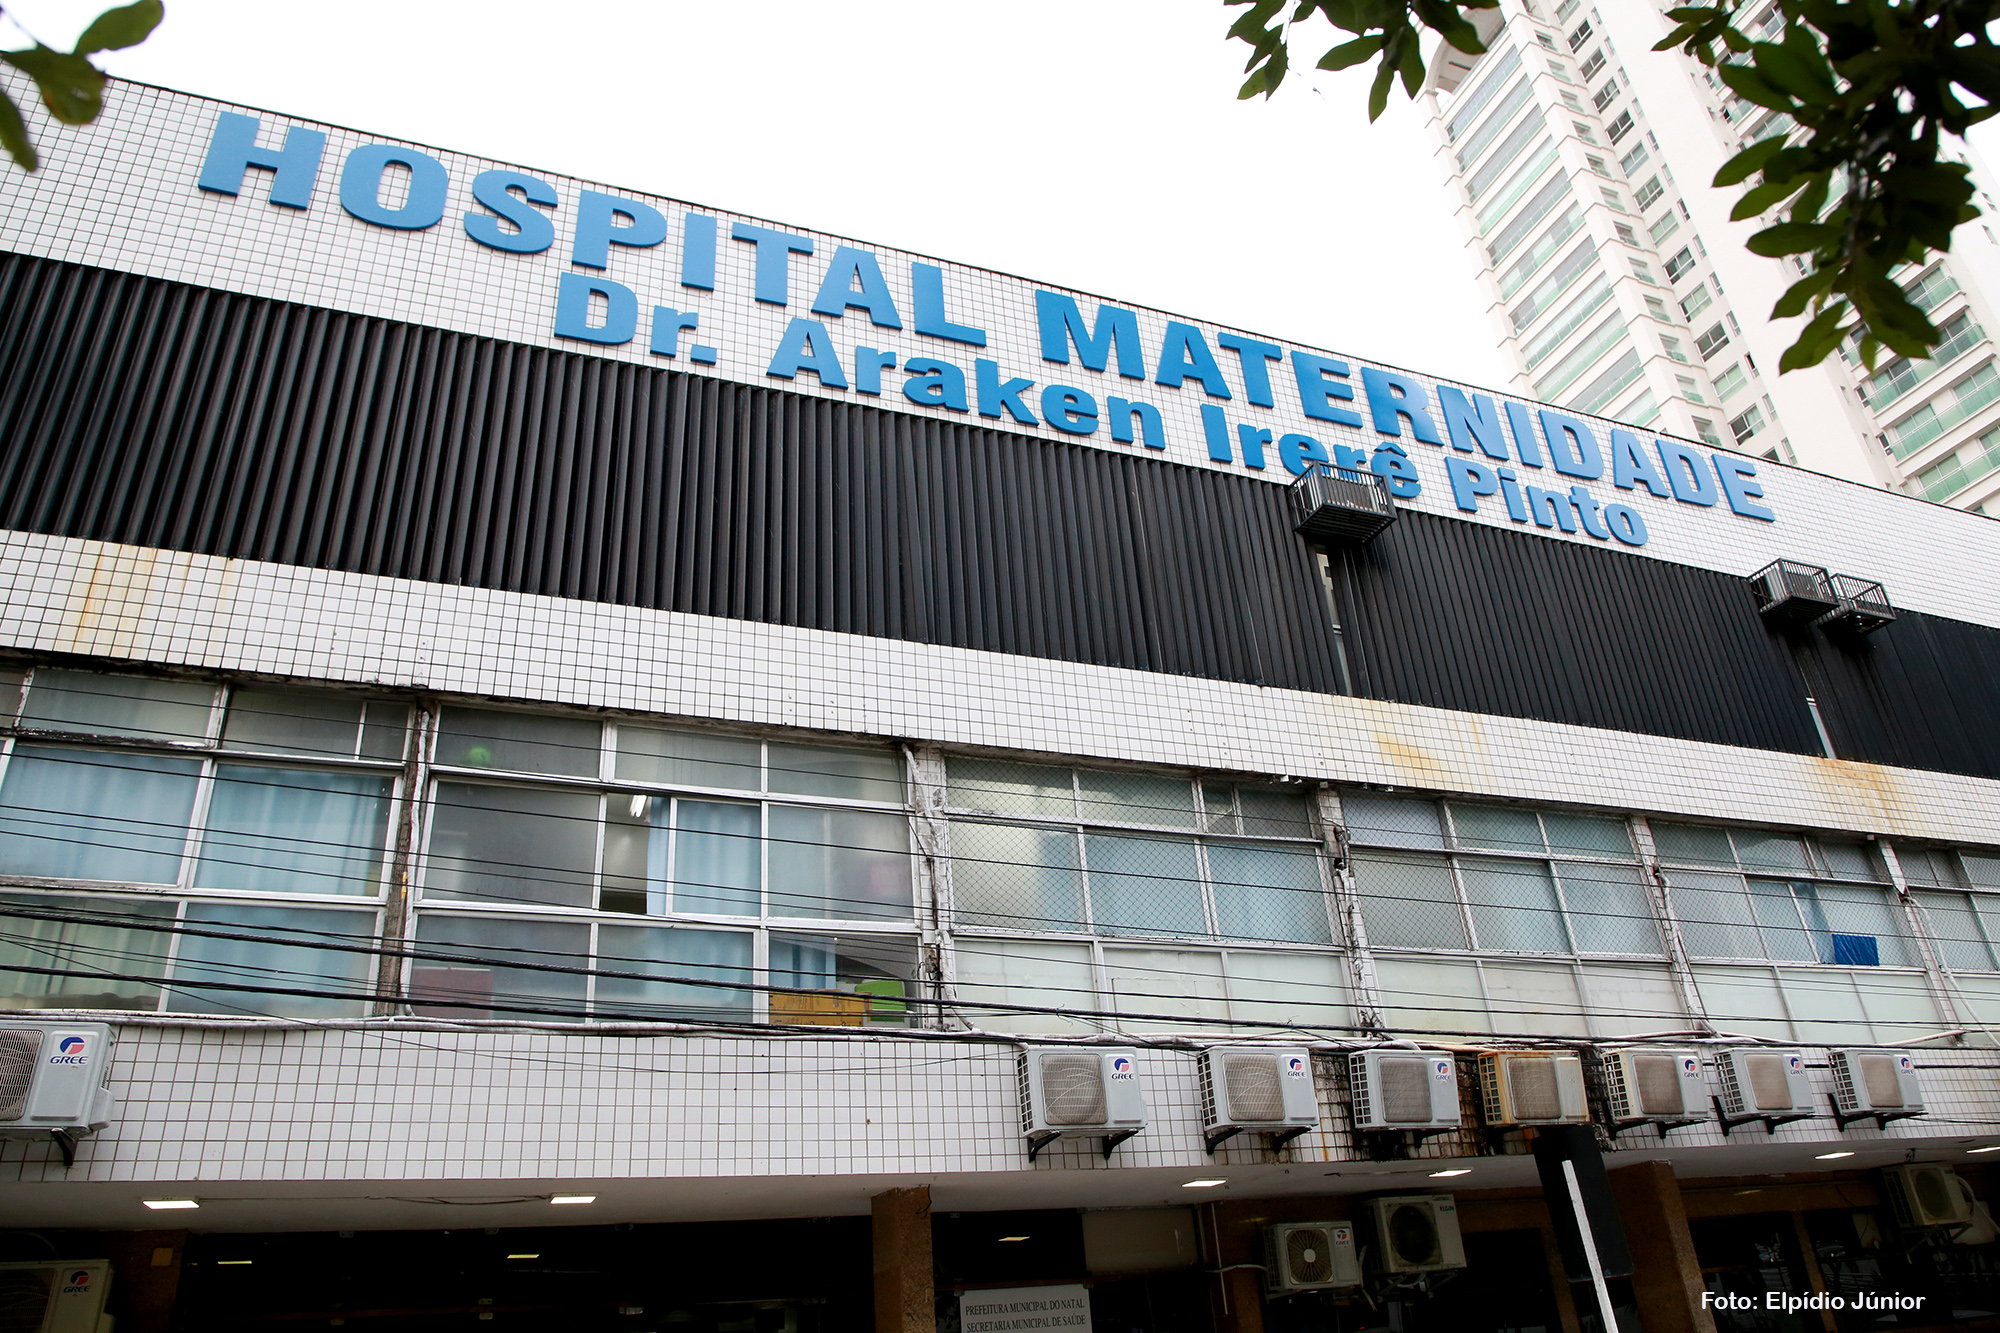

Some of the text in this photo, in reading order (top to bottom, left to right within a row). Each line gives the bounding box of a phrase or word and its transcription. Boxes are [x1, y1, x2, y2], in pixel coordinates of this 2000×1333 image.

[198, 110, 1775, 523] HOSPITAL MATERNIDADE
[554, 271, 1648, 547] Dr. Araken Irerê Pinto
[50, 1055, 88, 1065] GREE
[1111, 1072, 1135, 1080] GREE
[1684, 1071, 1700, 1079] GREE
[63, 1285, 91, 1293] GREE
[965, 1298, 1085, 1316] PREFEITURA MUNICIPAL DO NATAL
[966, 1313, 1086, 1333] SECRETARIA MUNICIPAL DE SAÚDE
